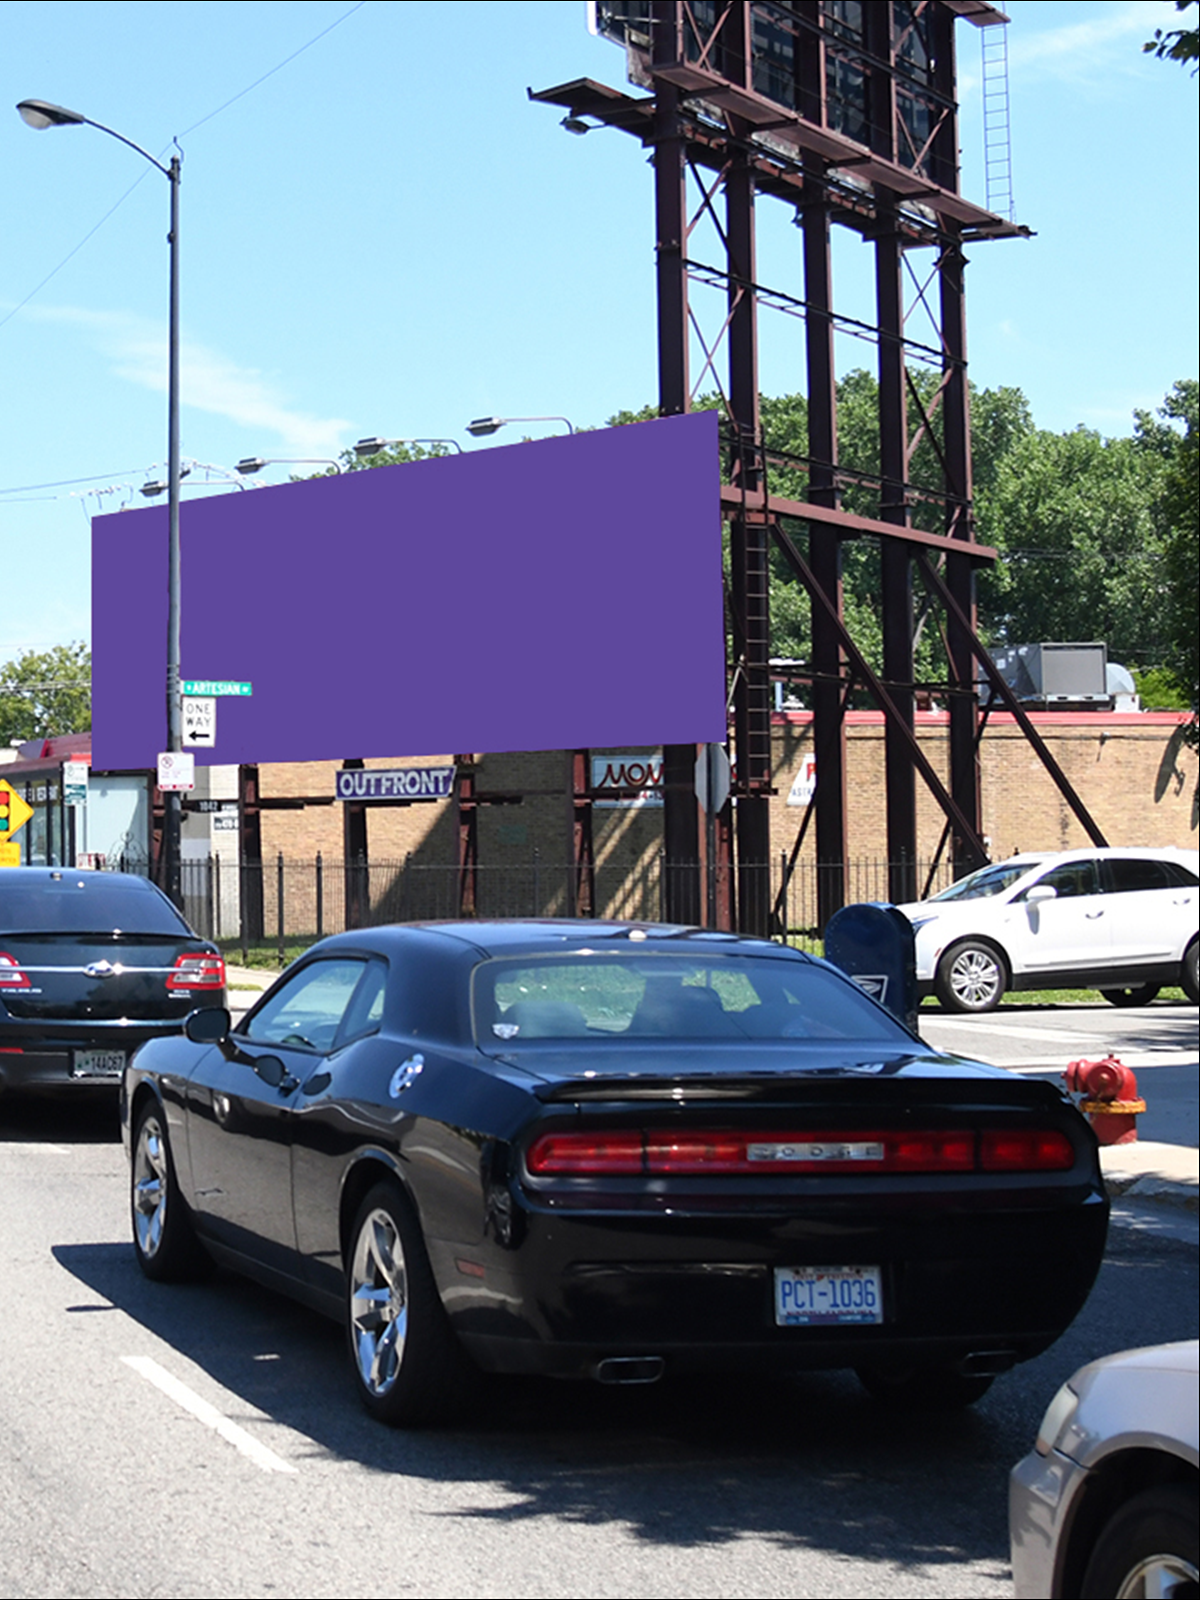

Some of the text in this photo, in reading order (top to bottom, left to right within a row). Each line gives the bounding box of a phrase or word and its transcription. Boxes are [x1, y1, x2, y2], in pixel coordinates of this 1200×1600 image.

[193, 681, 241, 695] ARTESIAN
[186, 703, 211, 715] ONE
[186, 716, 211, 728] WAY
[339, 768, 450, 796] OUTFRONT
[597, 763, 664, 788] MOM
[781, 1279, 876, 1309] PCT-1036
